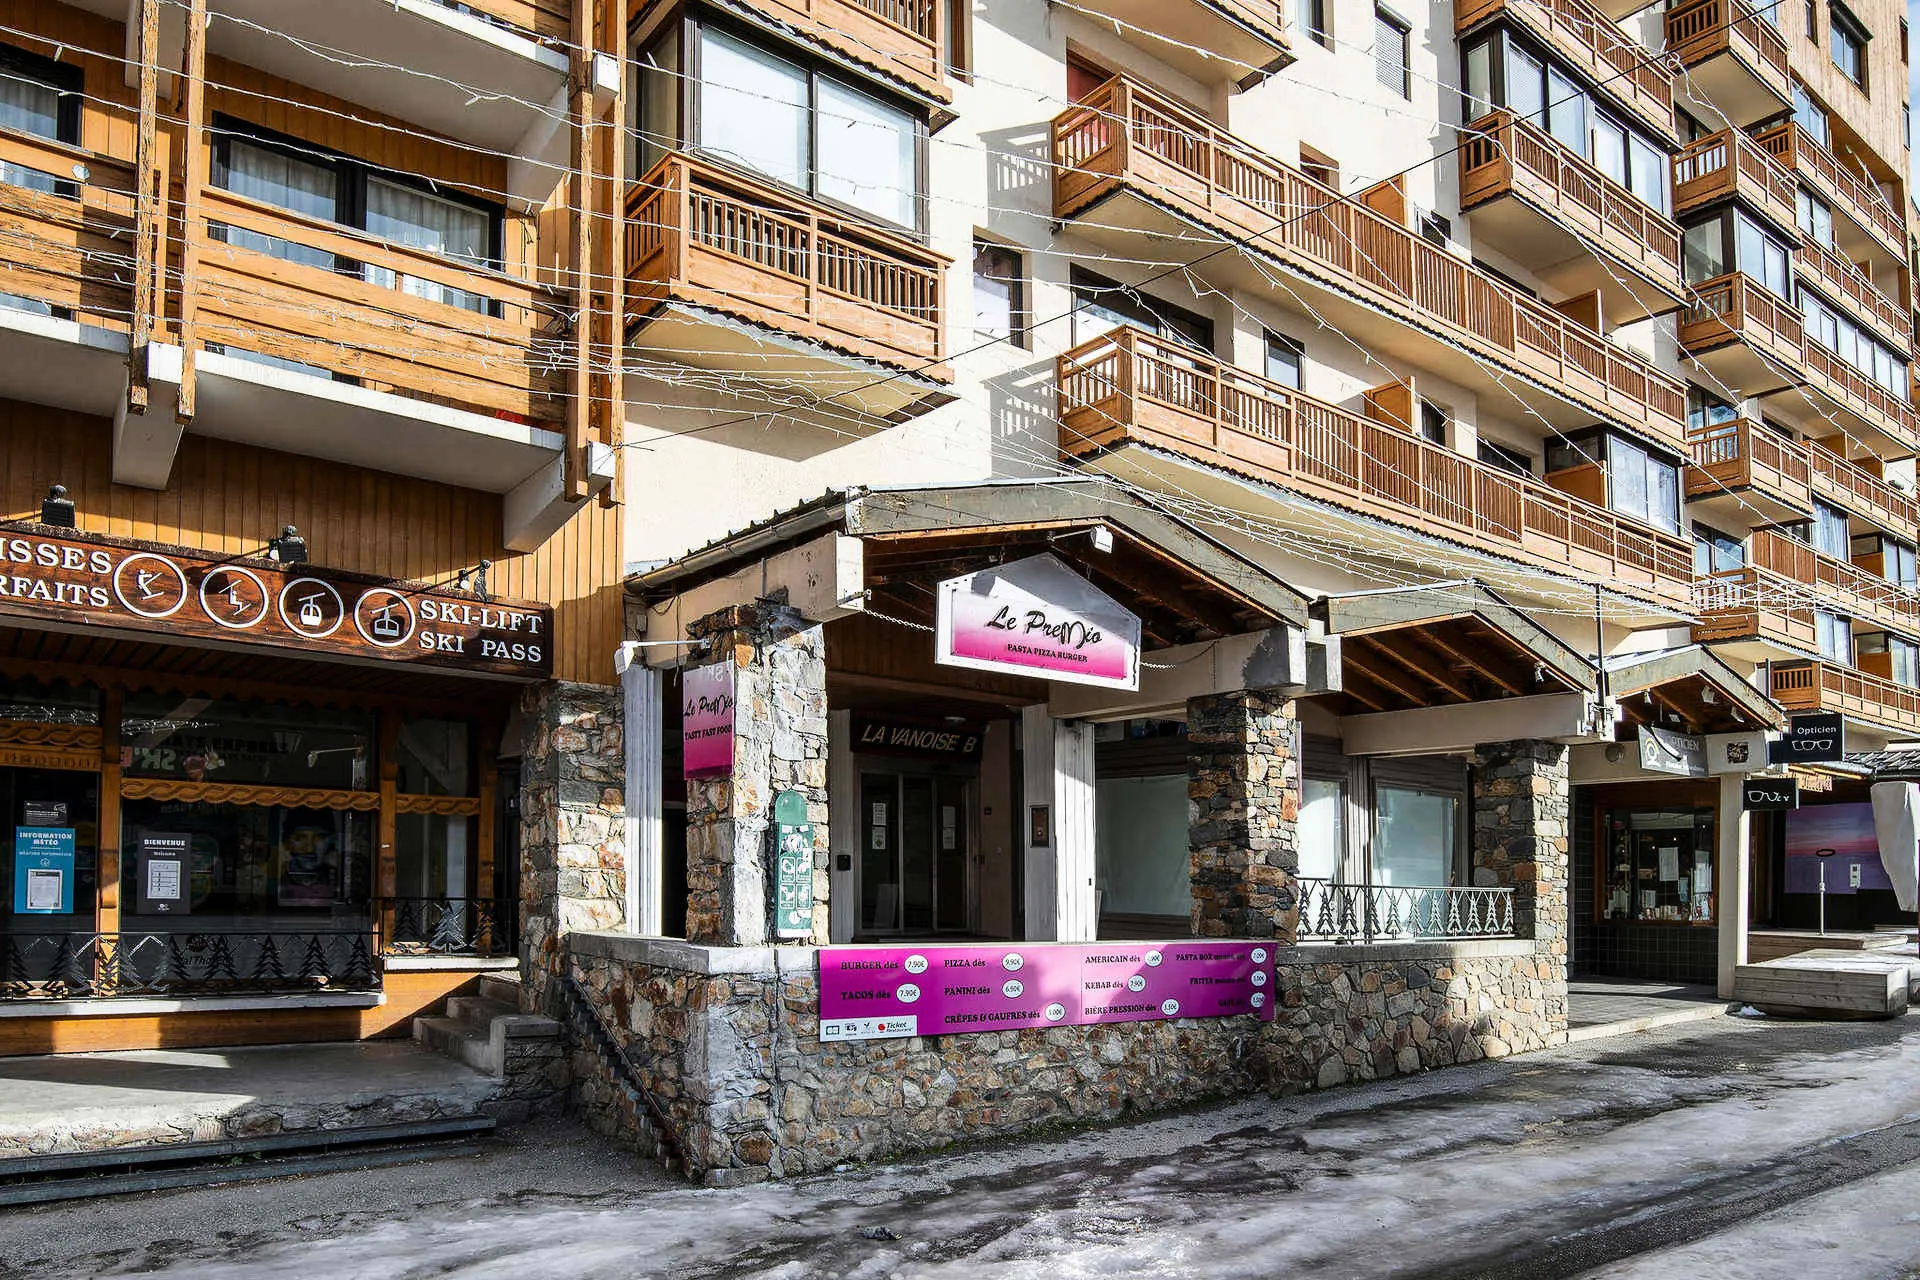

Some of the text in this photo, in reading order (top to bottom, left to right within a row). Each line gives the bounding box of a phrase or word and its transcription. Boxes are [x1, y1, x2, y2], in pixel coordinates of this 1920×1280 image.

[420, 600, 542, 634] SKI-LIFT
[986, 605, 1017, 630] Le
[420, 631, 542, 663] SKI PASS
[1007, 643, 1088, 663] PASTA PIZZA BURGER
[684, 699, 696, 717] Le
[702, 727, 716, 738] FAST
[716, 724, 732, 735] FOOD
[1797, 726, 1837, 735] Opticien
[861, 724, 977, 753] LA VANOISE B
[19, 832, 72, 840] INFORMATION
[1085, 955, 1128, 964] AMERICAIN
[1176, 953, 1197, 961] PASTA
[1199, 953, 1213, 961] BOX
[841, 960, 882, 970] BURGER
[944, 958, 986, 968] PIZZA dès
[1085, 981, 1111, 990] KEBAB
[841, 990, 874, 1001] TACOS
[944, 986, 991, 996] PANINI dès
[1109, 1004, 1144, 1014] PRESSION
[944, 1013, 978, 1024] CRÊPES
[988, 1010, 1027, 1021] GAUFRES
[1028, 1010, 1040, 1019] dès
[886, 1021, 907, 1029] Ticket
